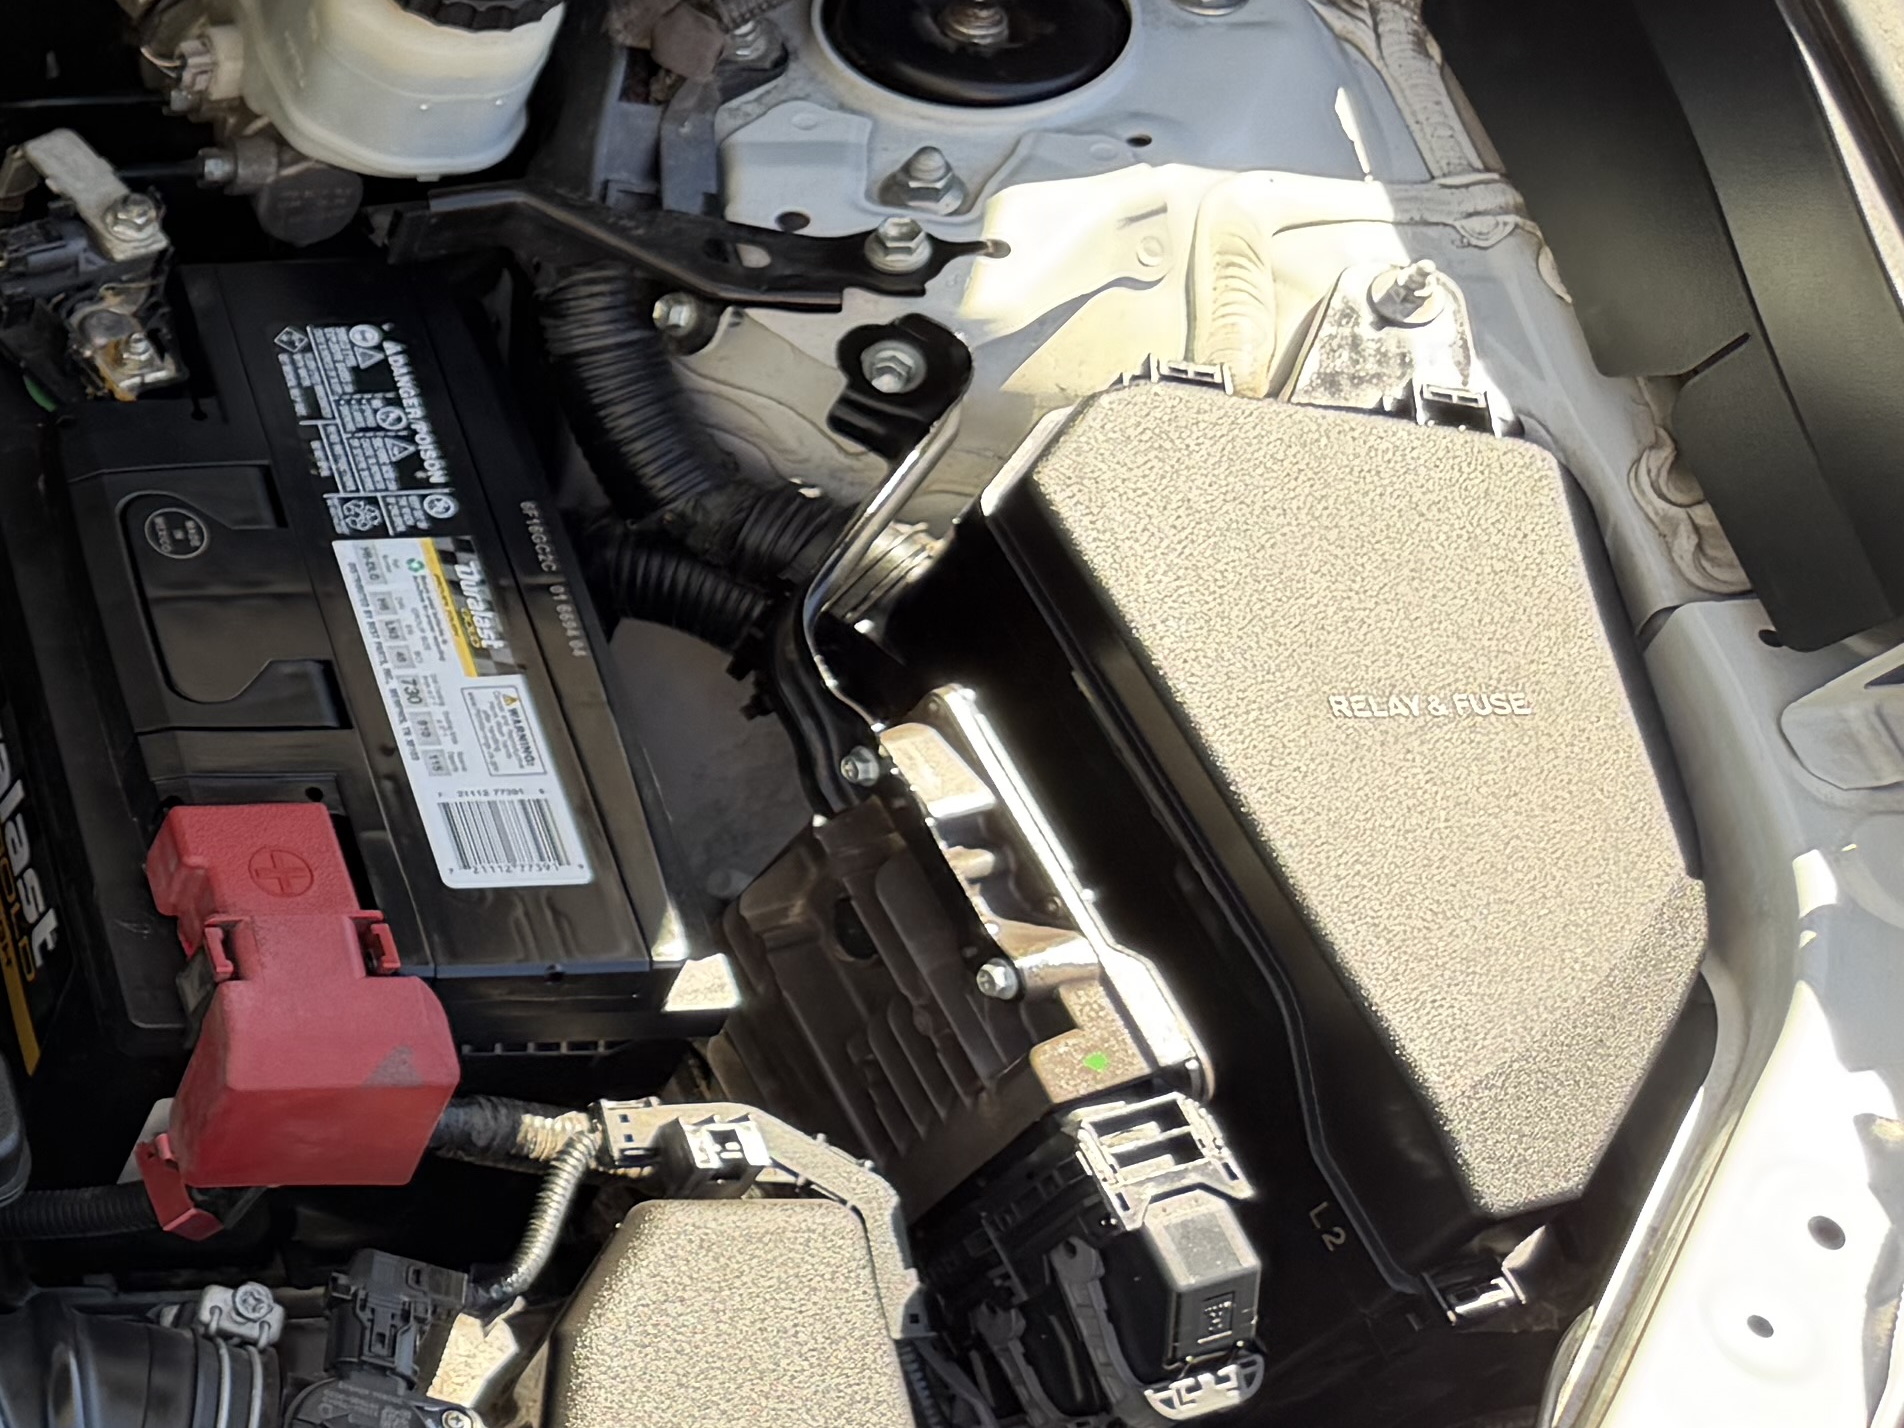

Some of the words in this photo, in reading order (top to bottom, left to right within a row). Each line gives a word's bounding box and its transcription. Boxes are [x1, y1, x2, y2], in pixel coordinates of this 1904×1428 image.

[452, 561, 505, 648] Duralast
[400, 678, 423, 703] 730
[1328, 694, 1419, 717] RELAY
[1427, 694, 1448, 717] &
[1453, 692, 1531, 716] FUSE
[1309, 1200, 1347, 1252] L2
